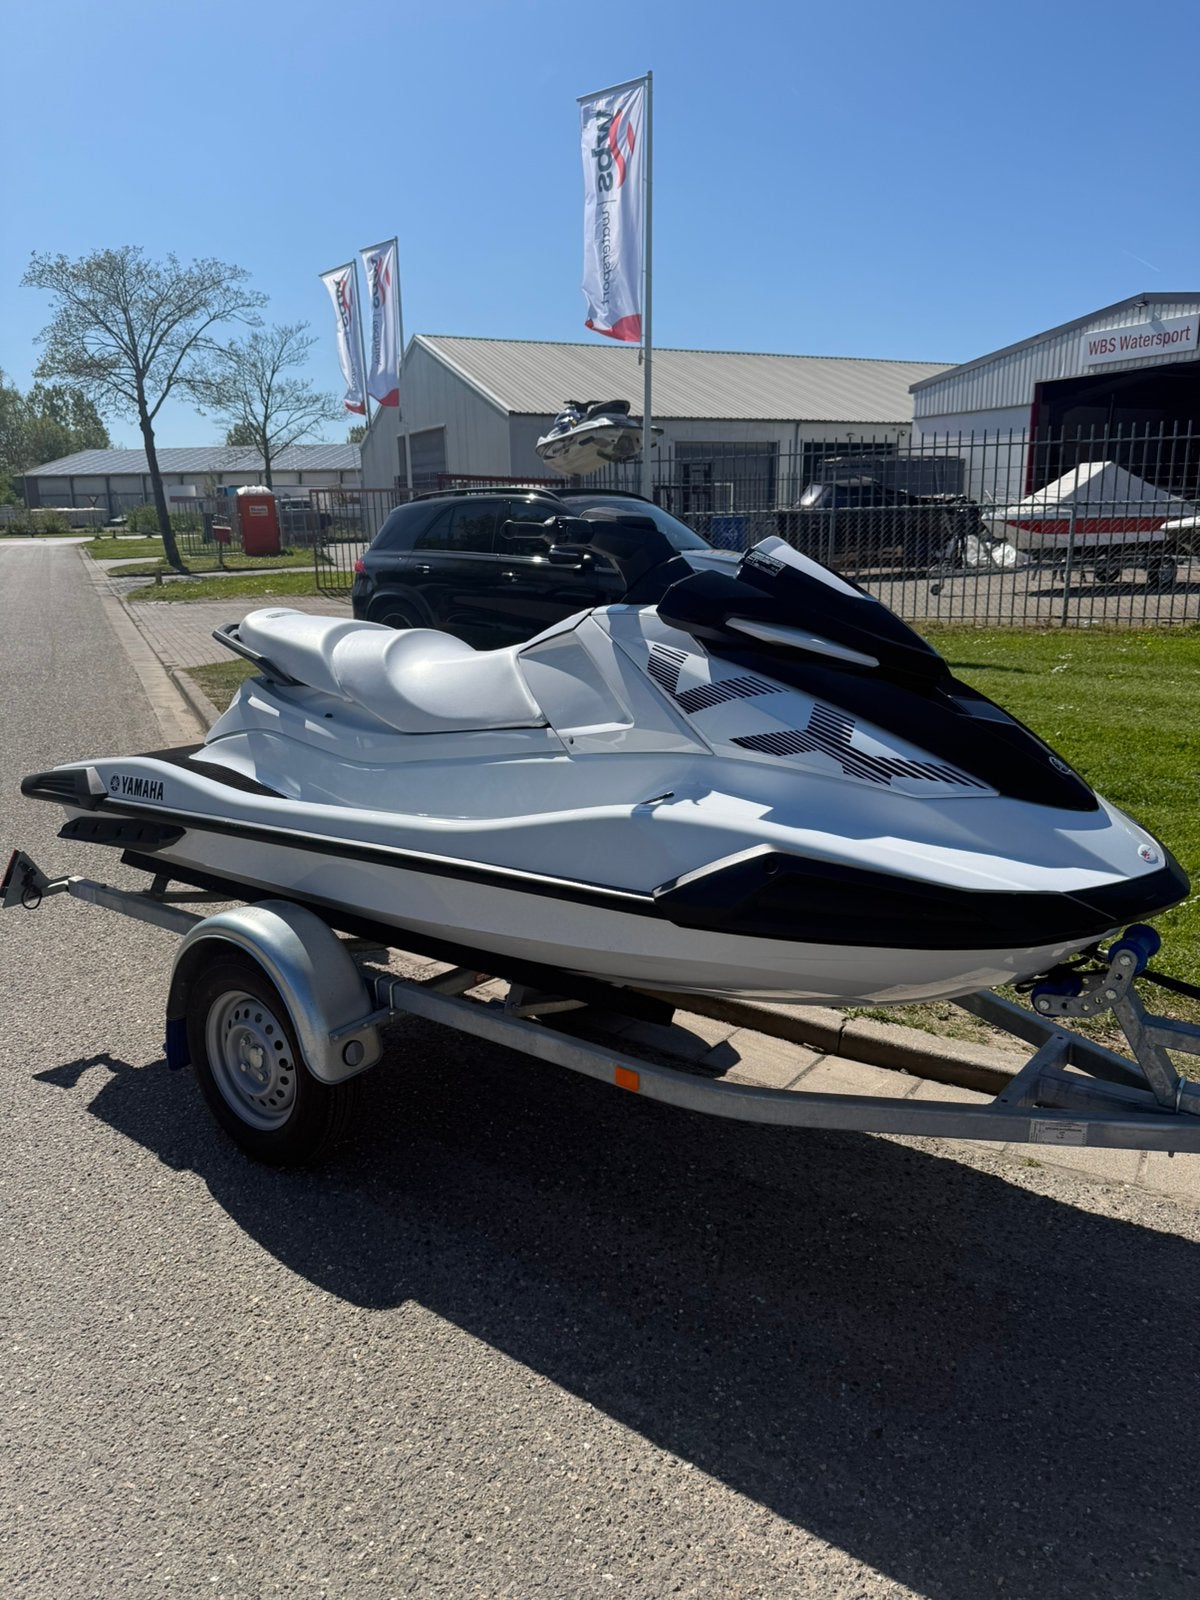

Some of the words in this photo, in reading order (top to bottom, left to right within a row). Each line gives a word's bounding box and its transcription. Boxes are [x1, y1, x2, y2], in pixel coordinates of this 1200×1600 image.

[1089, 337, 1117, 355] WBS
[1120, 326, 1191, 351] Watersport
[122, 776, 163, 800] YAMAHA
